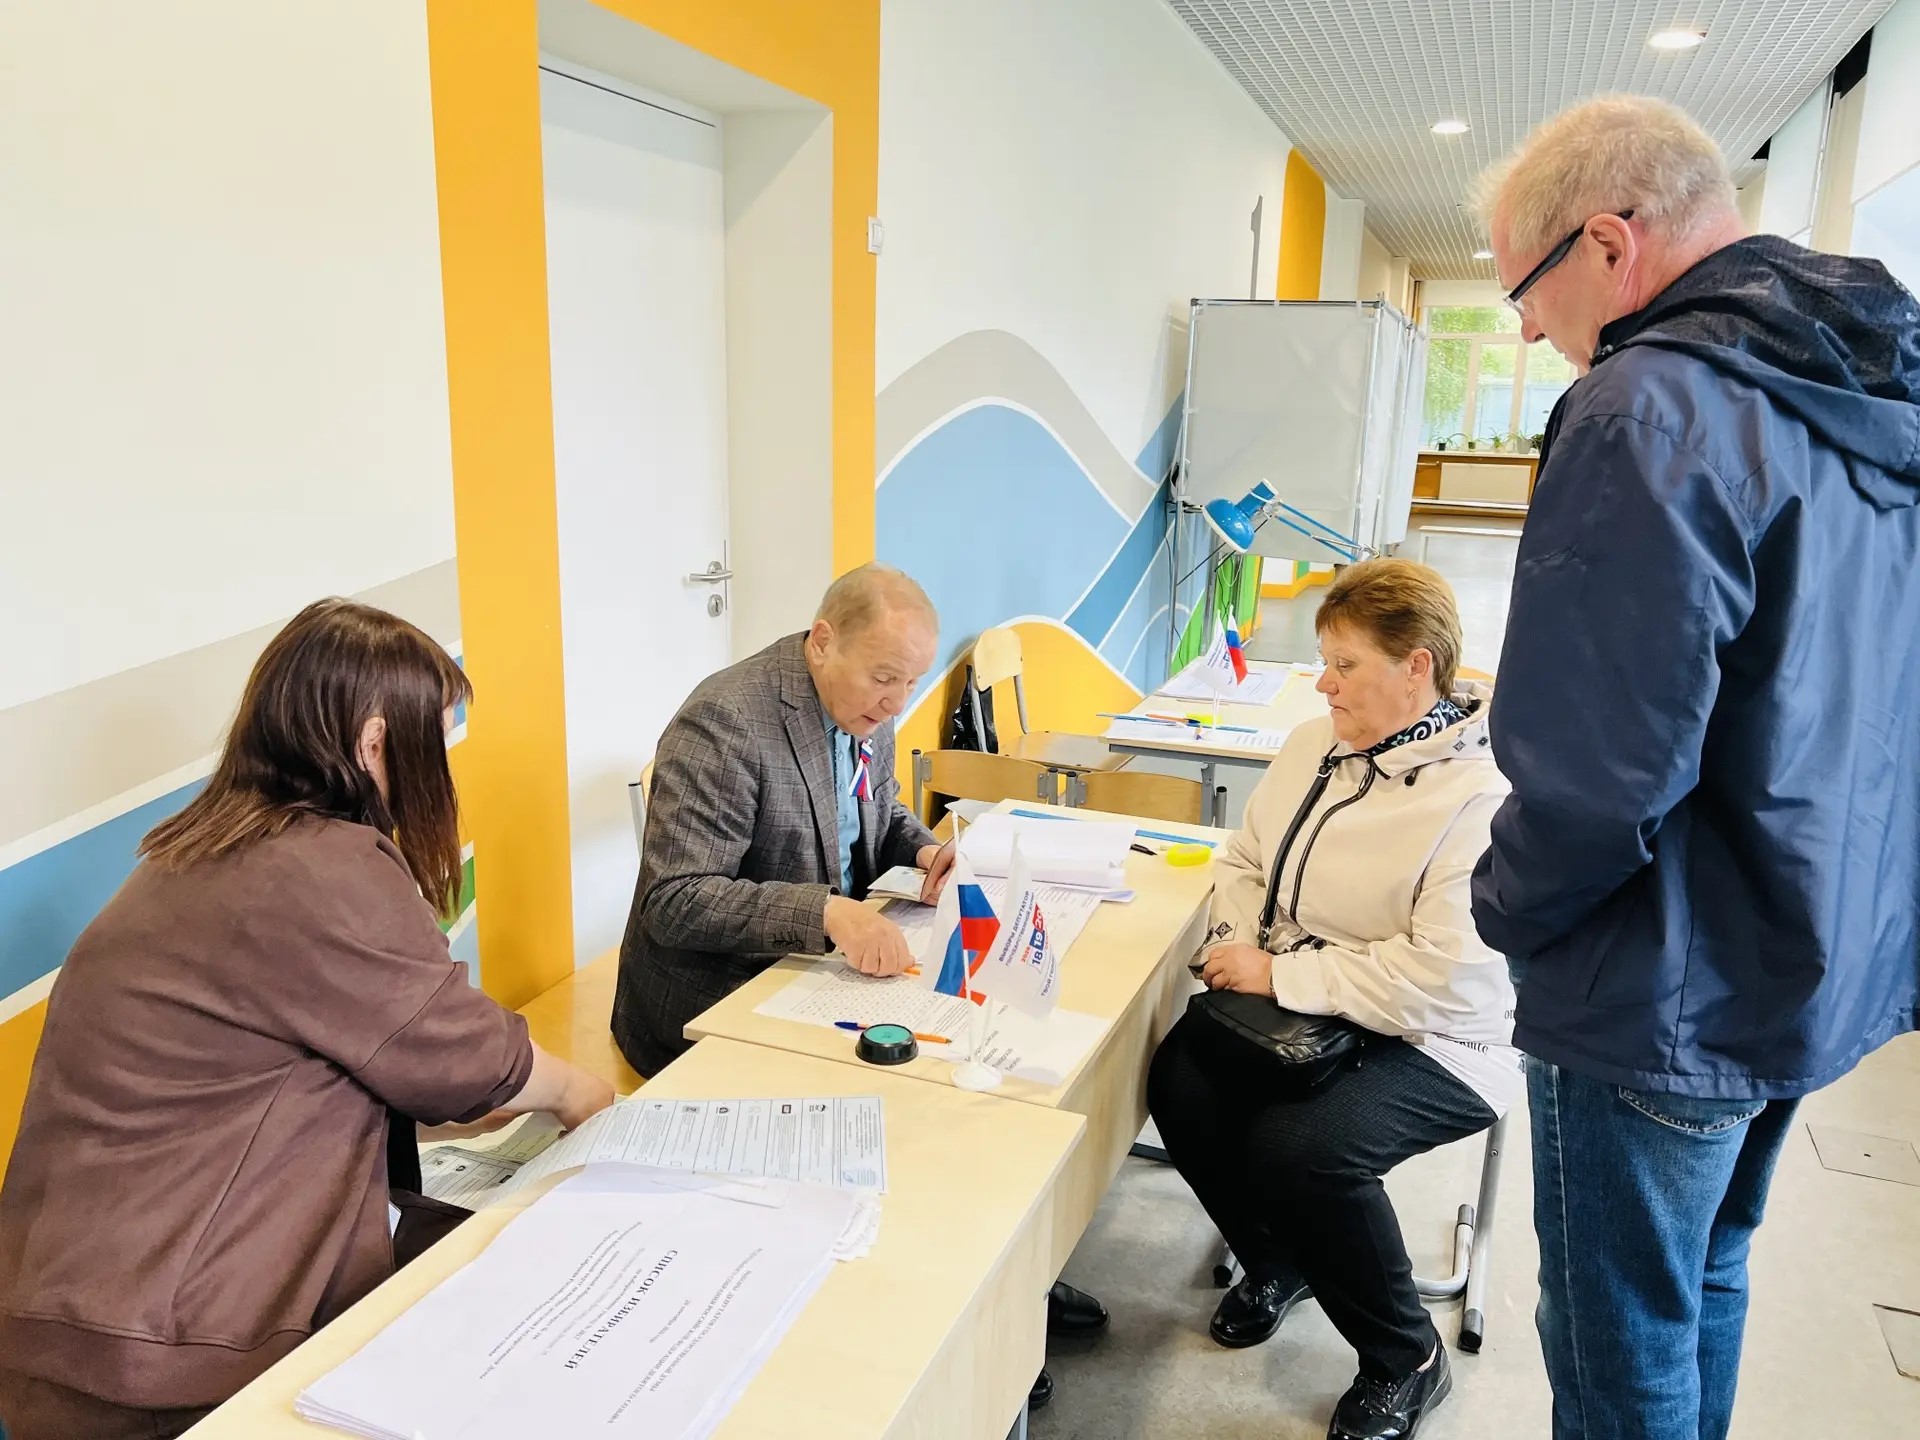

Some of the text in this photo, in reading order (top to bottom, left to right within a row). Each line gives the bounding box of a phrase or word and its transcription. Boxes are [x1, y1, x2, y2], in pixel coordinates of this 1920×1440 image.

[1033, 931, 1043, 946] 19
[1032, 950, 1043, 964] 18
[634, 1249, 679, 1294] СПИСОК
[562, 1297, 641, 1369] ИЗБИРАТЕЛЕЙ
